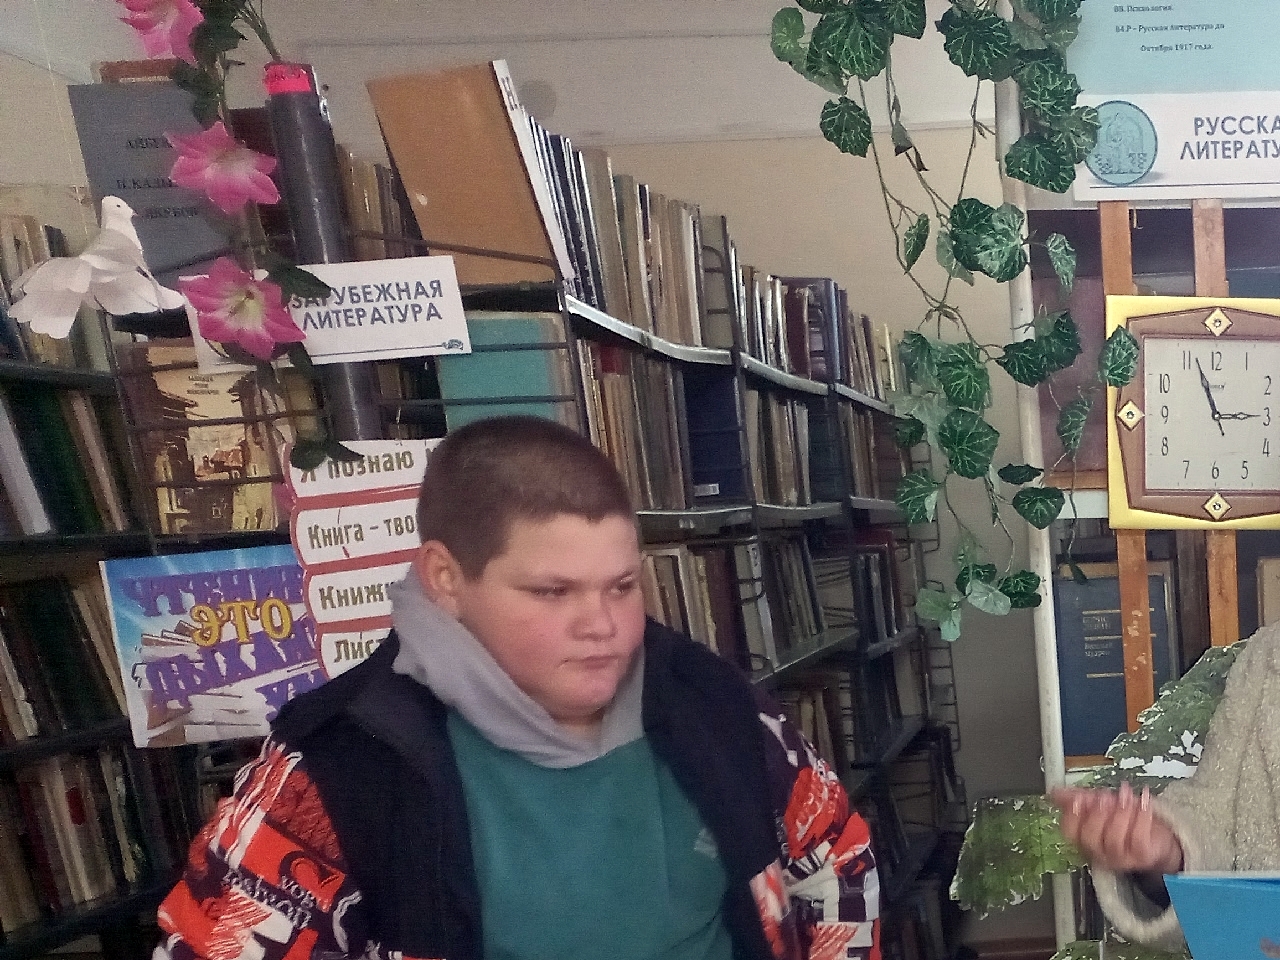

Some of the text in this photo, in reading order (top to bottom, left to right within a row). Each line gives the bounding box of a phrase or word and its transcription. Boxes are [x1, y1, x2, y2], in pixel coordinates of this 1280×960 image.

[303, 302, 443, 330] ЛИТЕРАТУРА
[1182, 350, 1191, 370] 11
[1211, 351, 1223, 371] 12
[1245, 351, 1249, 371] 1
[1159, 373, 1171, 393] 10
[1263, 375, 1272, 395] 2
[1161, 405, 1170, 425] 9
[1263, 407, 1271, 426] 3
[1160, 437, 1169, 457] 8
[1262, 438, 1270, 457] 4
[327, 450, 415, 480] познаю
[1182, 460, 1190, 480] 7
[1211, 461, 1220, 480] 6
[1241, 461, 1249, 480] 5
[307, 522, 364, 549] Книга
[383, 514, 419, 537] тво
[189, 597, 294, 647] ЭТО
